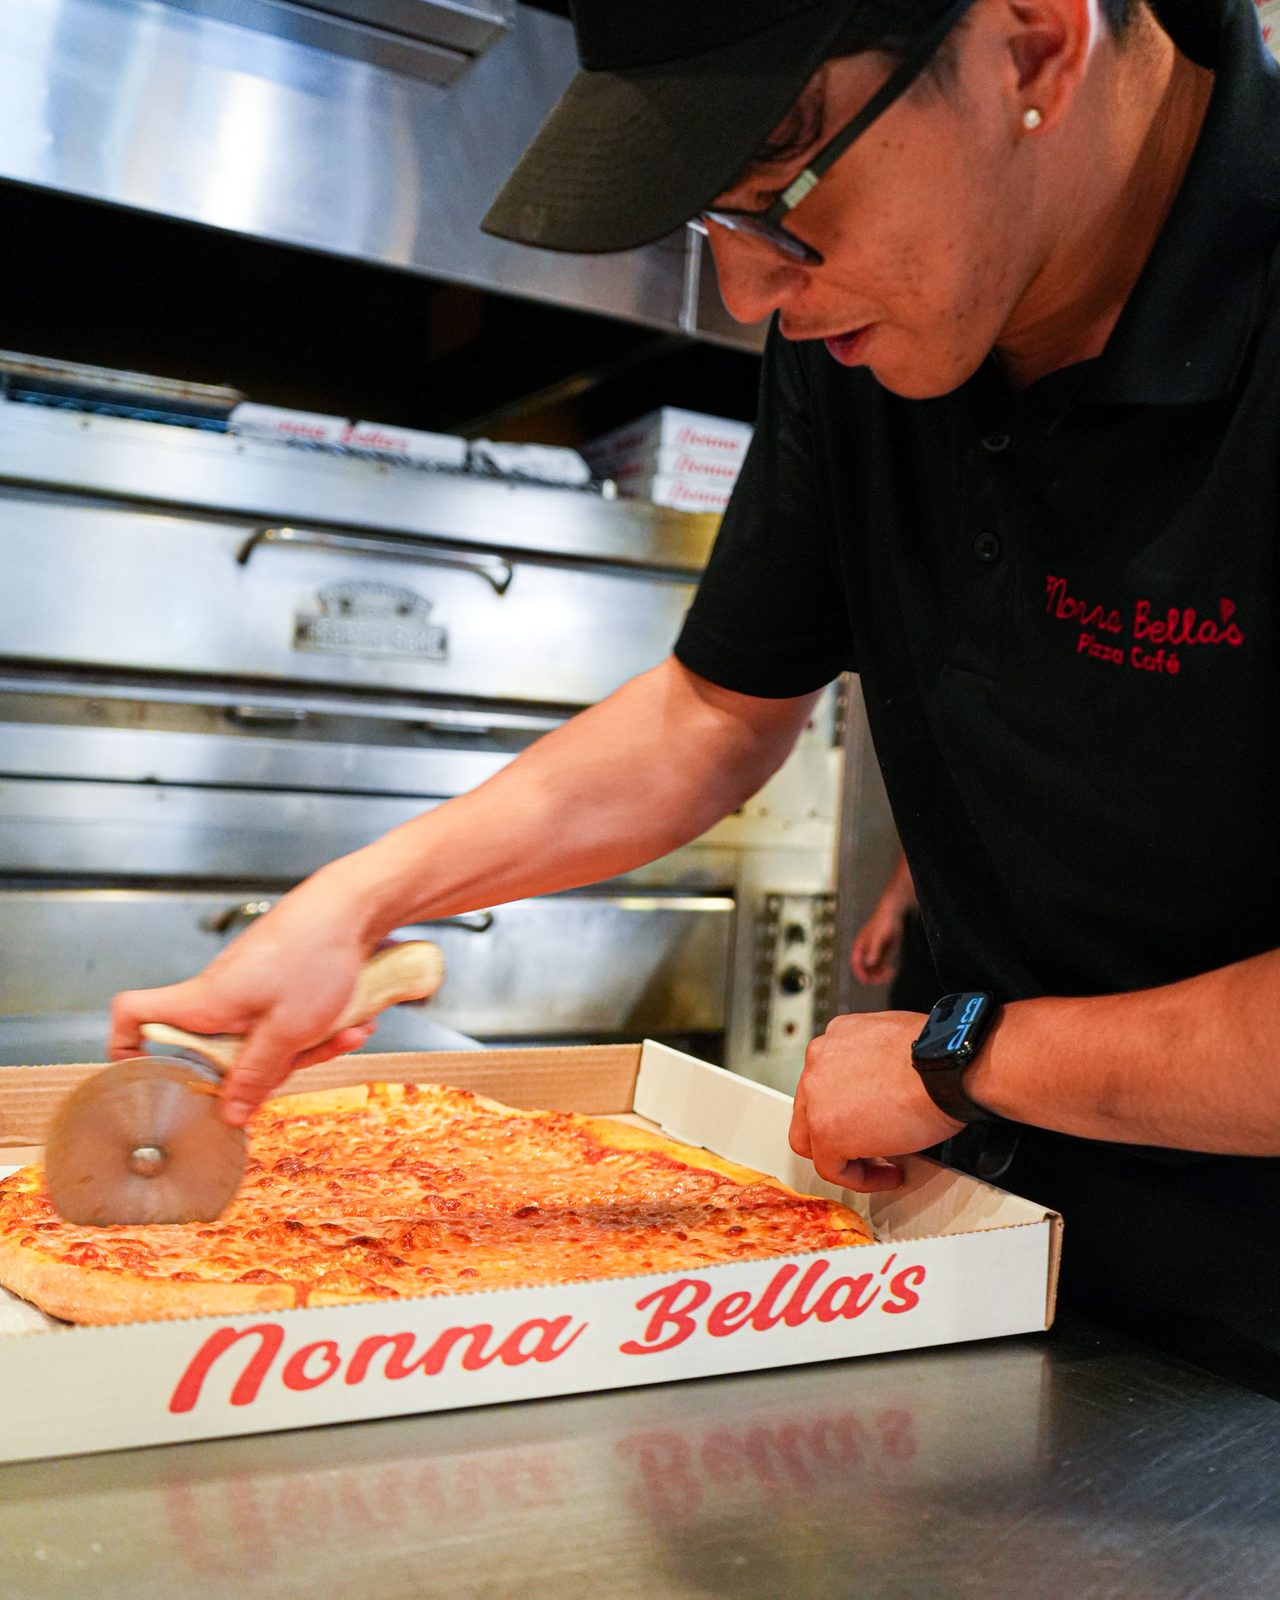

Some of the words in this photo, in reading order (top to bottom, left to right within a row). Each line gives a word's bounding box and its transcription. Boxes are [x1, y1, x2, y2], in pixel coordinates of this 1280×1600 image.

[1133, 597, 1245, 646] Bella's
[1076, 632, 1124, 665] Pizza
[1130, 645, 1180, 675] Café
[168, 1313, 588, 1415] Nonna
[619, 1252, 927, 1356] Bella's
